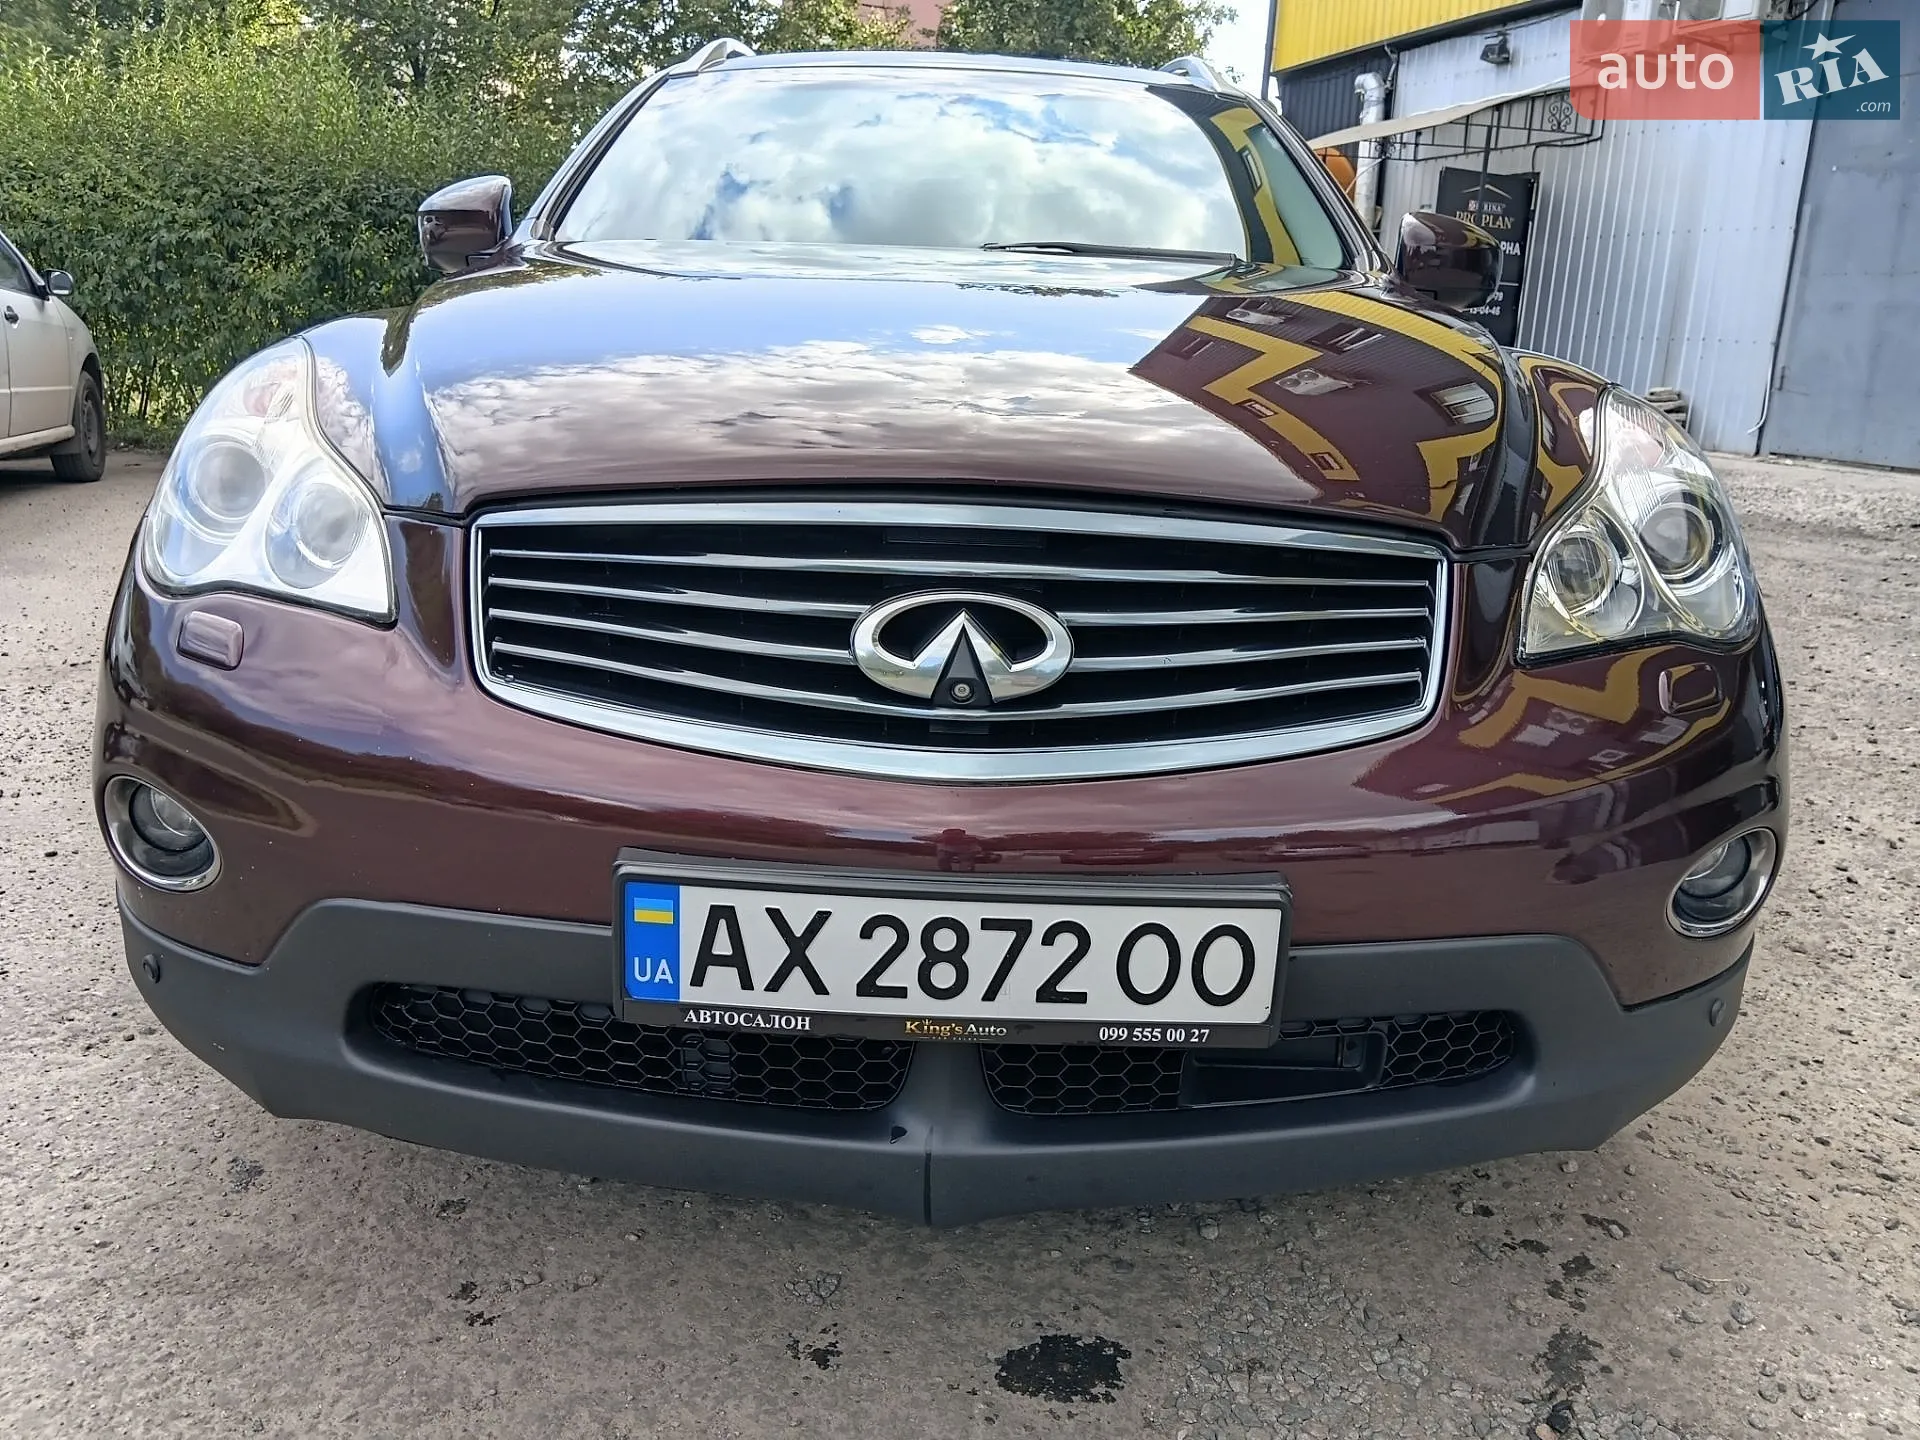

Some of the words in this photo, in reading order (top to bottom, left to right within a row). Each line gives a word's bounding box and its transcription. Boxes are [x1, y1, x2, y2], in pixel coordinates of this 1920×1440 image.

[1481, 213, 1512, 230] PLAN
[689, 904, 833, 996] AX
[855, 913, 1092, 1004] 2872
[633, 957, 674, 986] UA
[683, 1009, 812, 1031] АВТОСАЛОН
[1099, 1026, 1129, 1041] 099
[1132, 1027, 1162, 1042] 555
[1166, 1028, 1186, 1043] 00
[1189, 1028, 1210, 1043] 27
